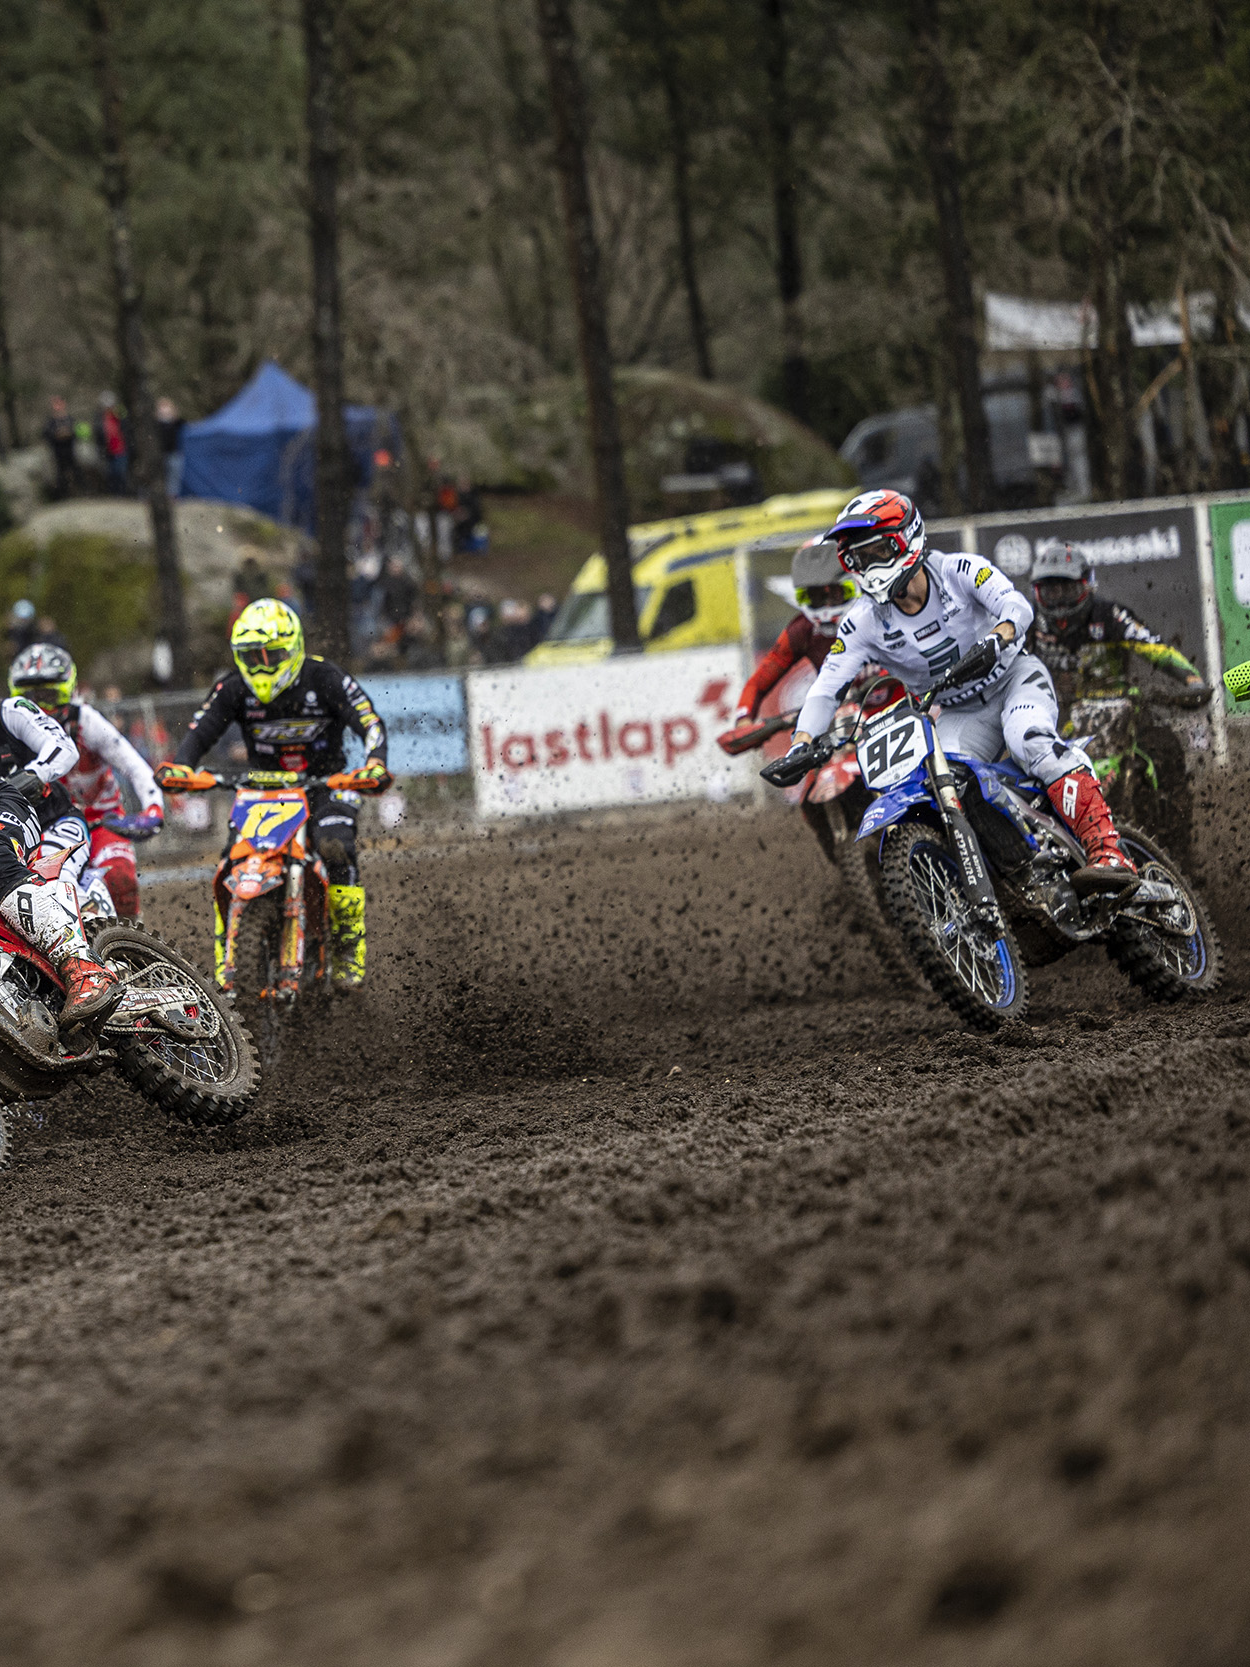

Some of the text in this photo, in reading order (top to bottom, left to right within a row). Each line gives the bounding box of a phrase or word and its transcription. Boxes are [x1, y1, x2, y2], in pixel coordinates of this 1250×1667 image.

[1034, 523, 1182, 568] Kwasaki
[481, 709, 700, 771] lastlap
[866, 720, 916, 784] 92
[240, 801, 305, 839] 17
